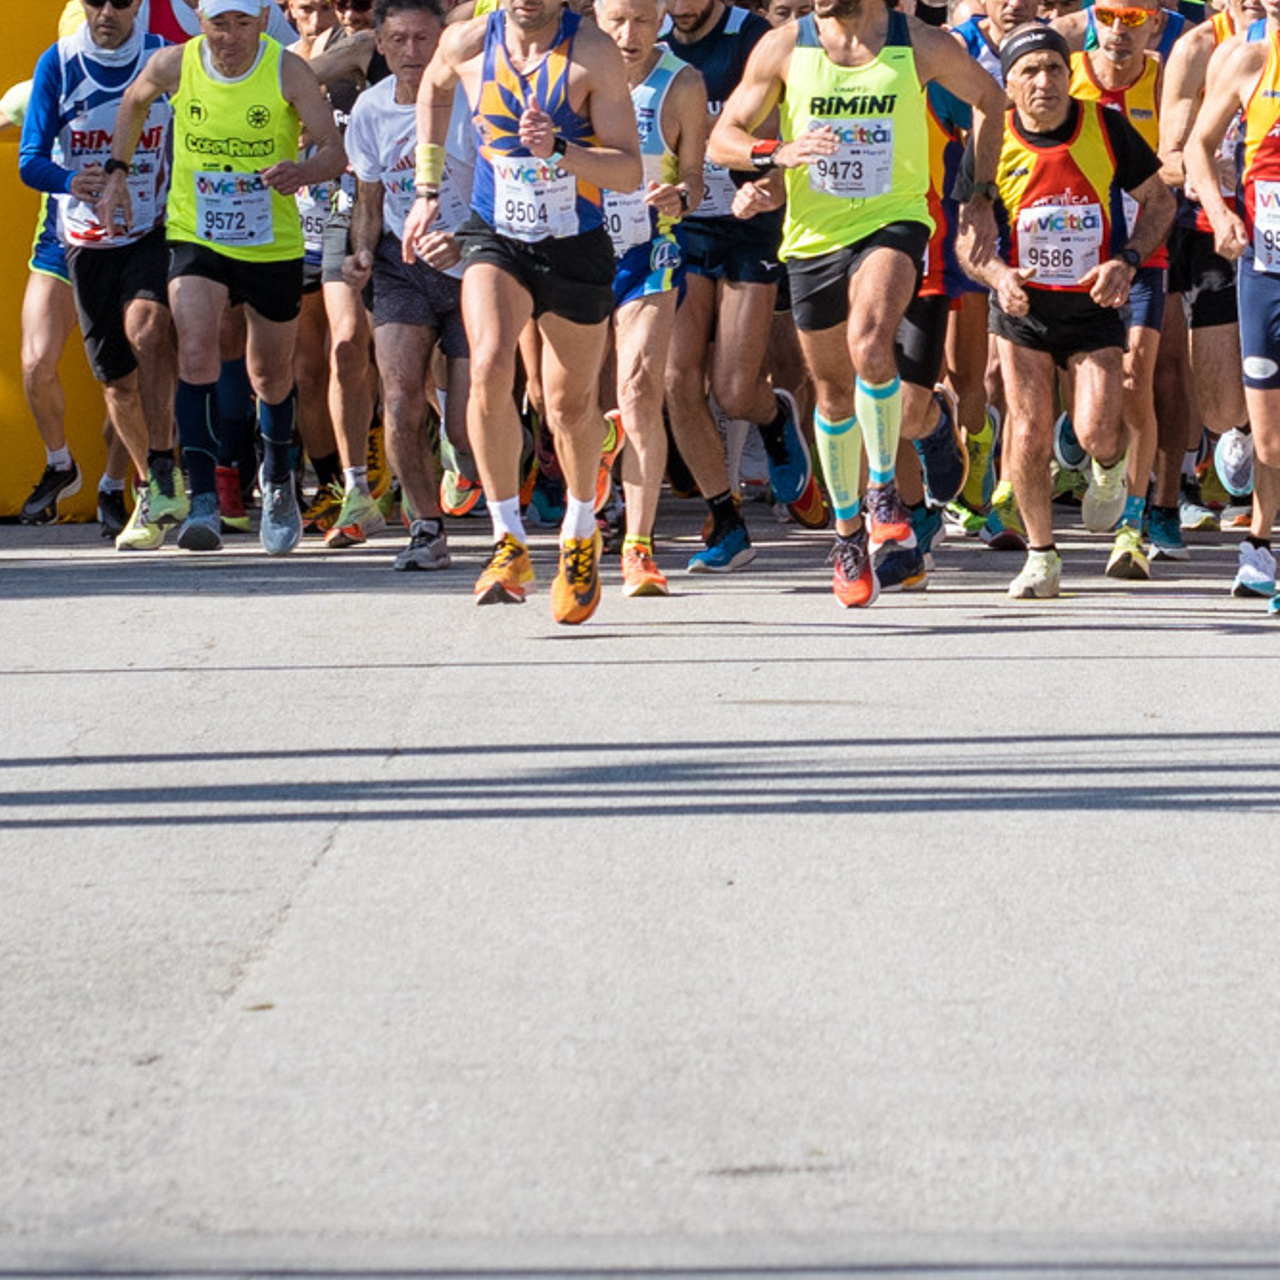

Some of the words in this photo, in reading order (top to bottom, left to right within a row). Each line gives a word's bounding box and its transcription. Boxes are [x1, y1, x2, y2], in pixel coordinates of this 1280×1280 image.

[810, 94, 898, 116] RIMINI
[70, 125, 163, 149] RIMNI
[817, 159, 864, 180] 9473
[205, 210, 246, 230] 9572
[505, 200, 548, 223] 9504
[1028, 247, 1074, 267] 9586
